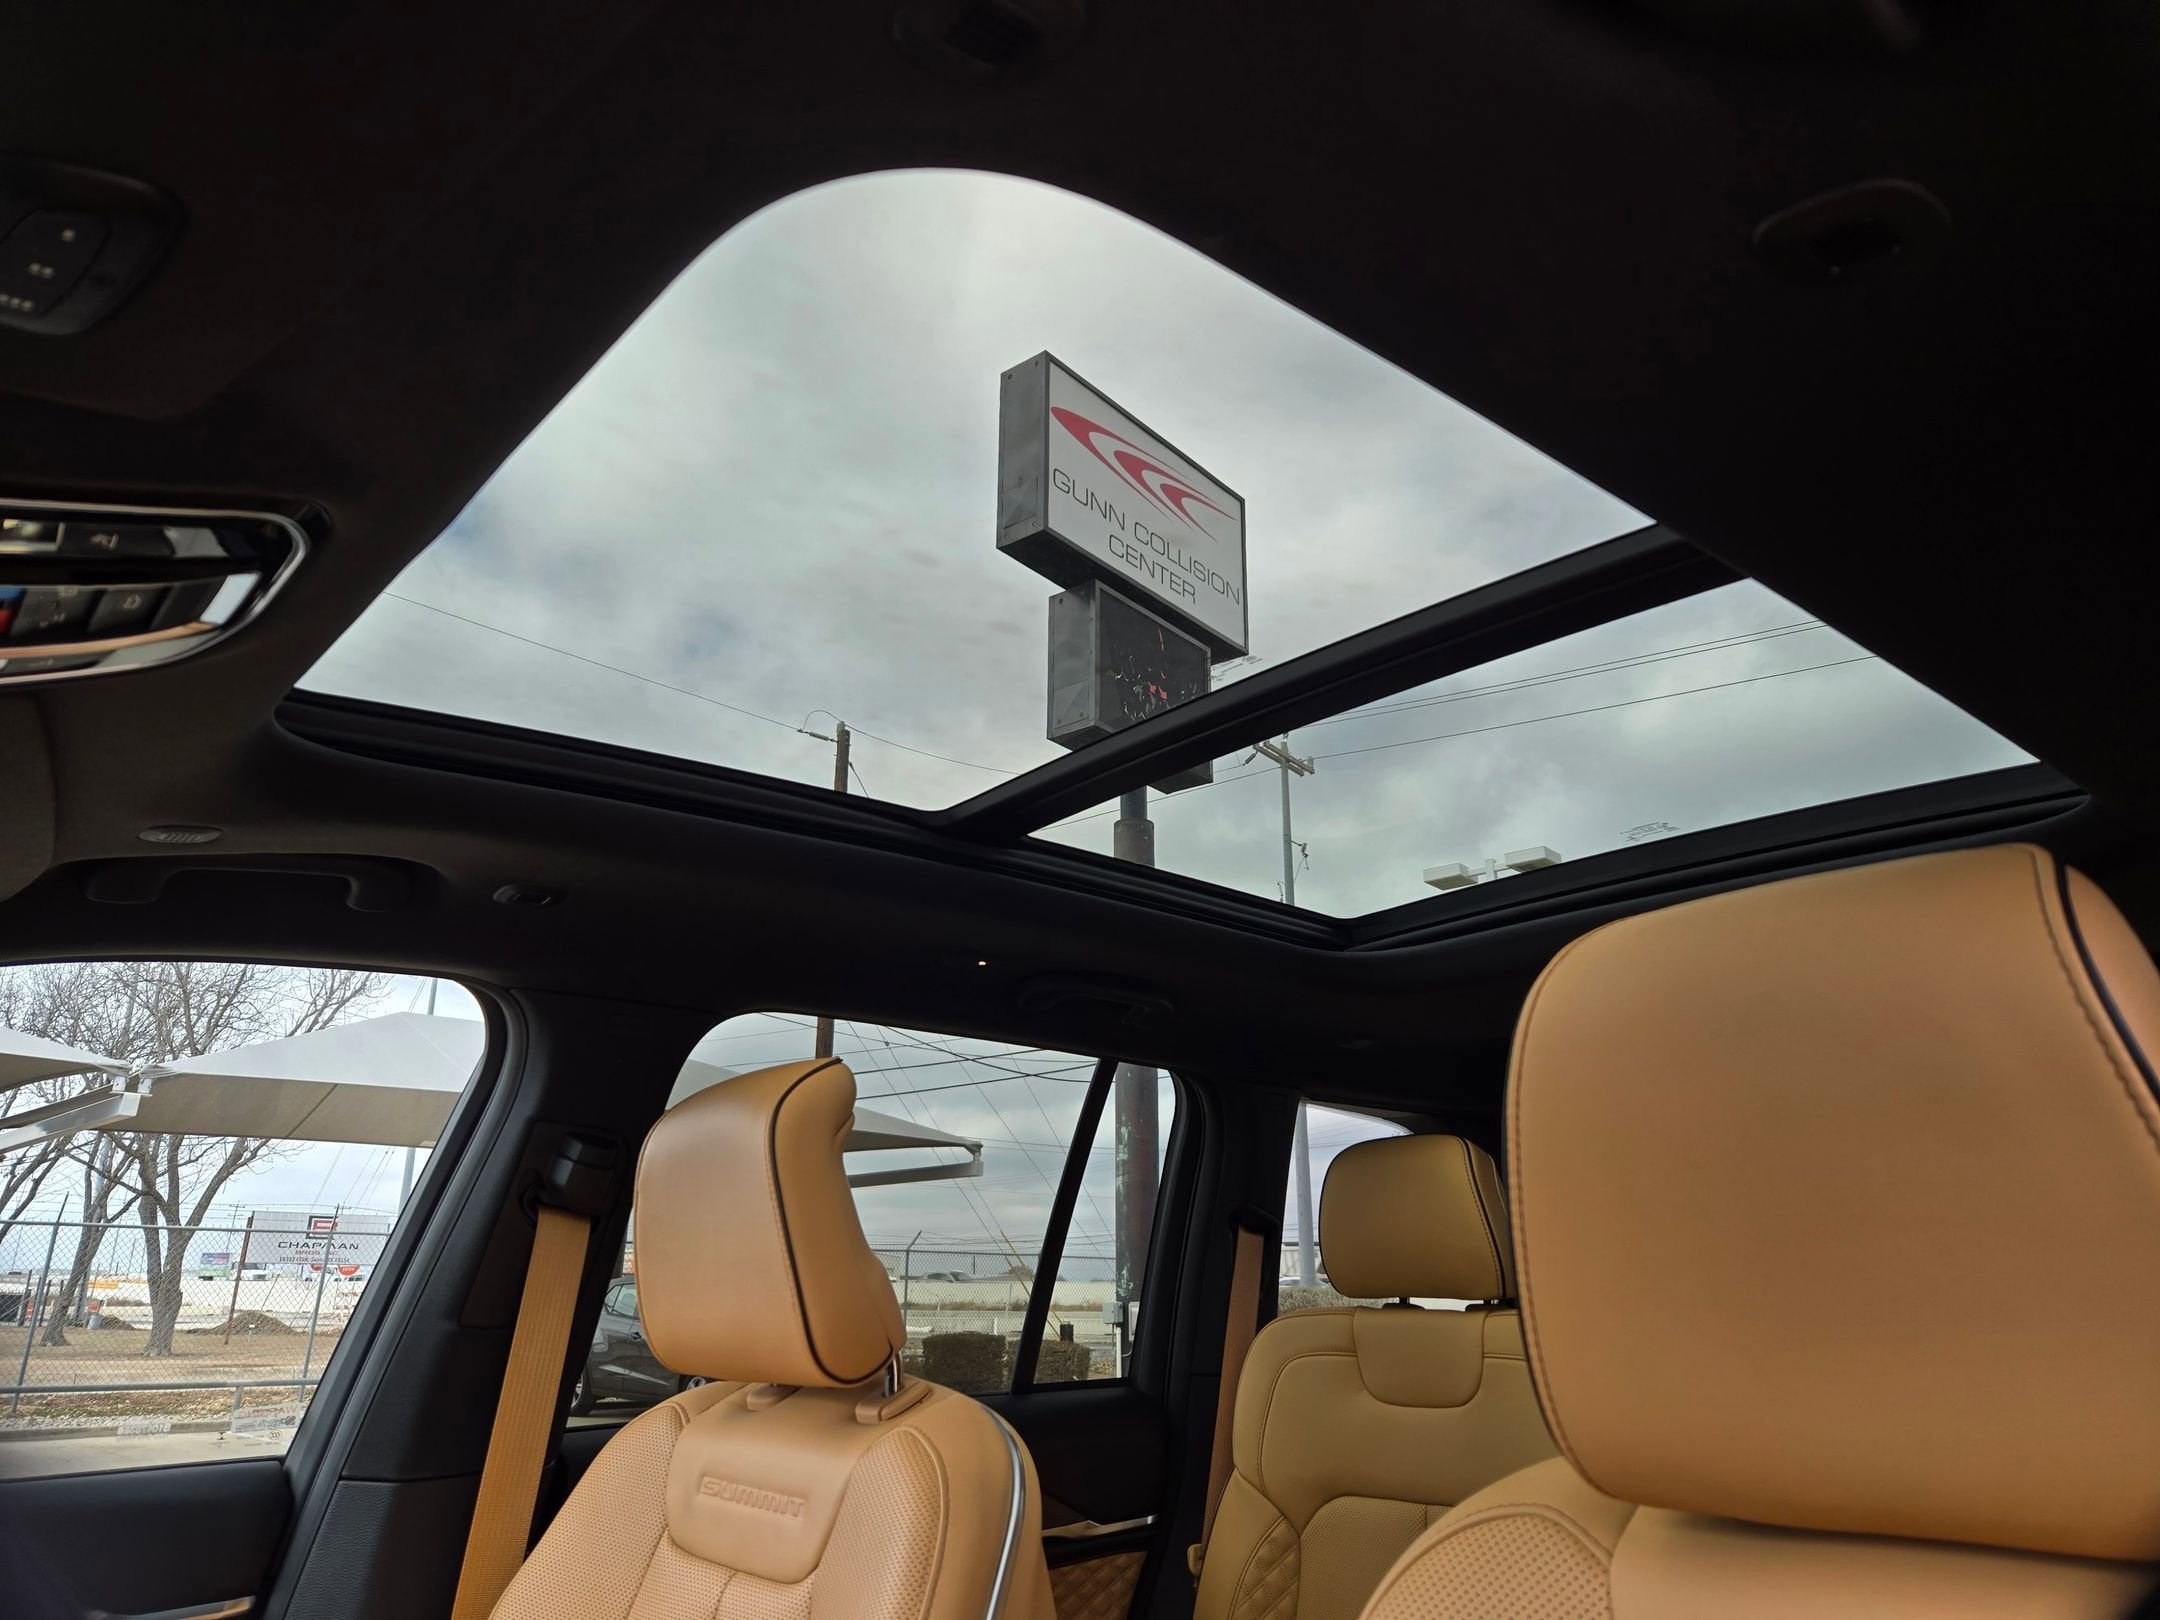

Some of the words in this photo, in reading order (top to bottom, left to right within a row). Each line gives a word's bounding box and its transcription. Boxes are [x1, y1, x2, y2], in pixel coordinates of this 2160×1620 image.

[1053, 467, 1126, 531] GUNN
[1134, 521, 1240, 606] COLLISION
[1109, 535, 1196, 604] CENTER
[700, 1475, 807, 1518] SUMMIT
